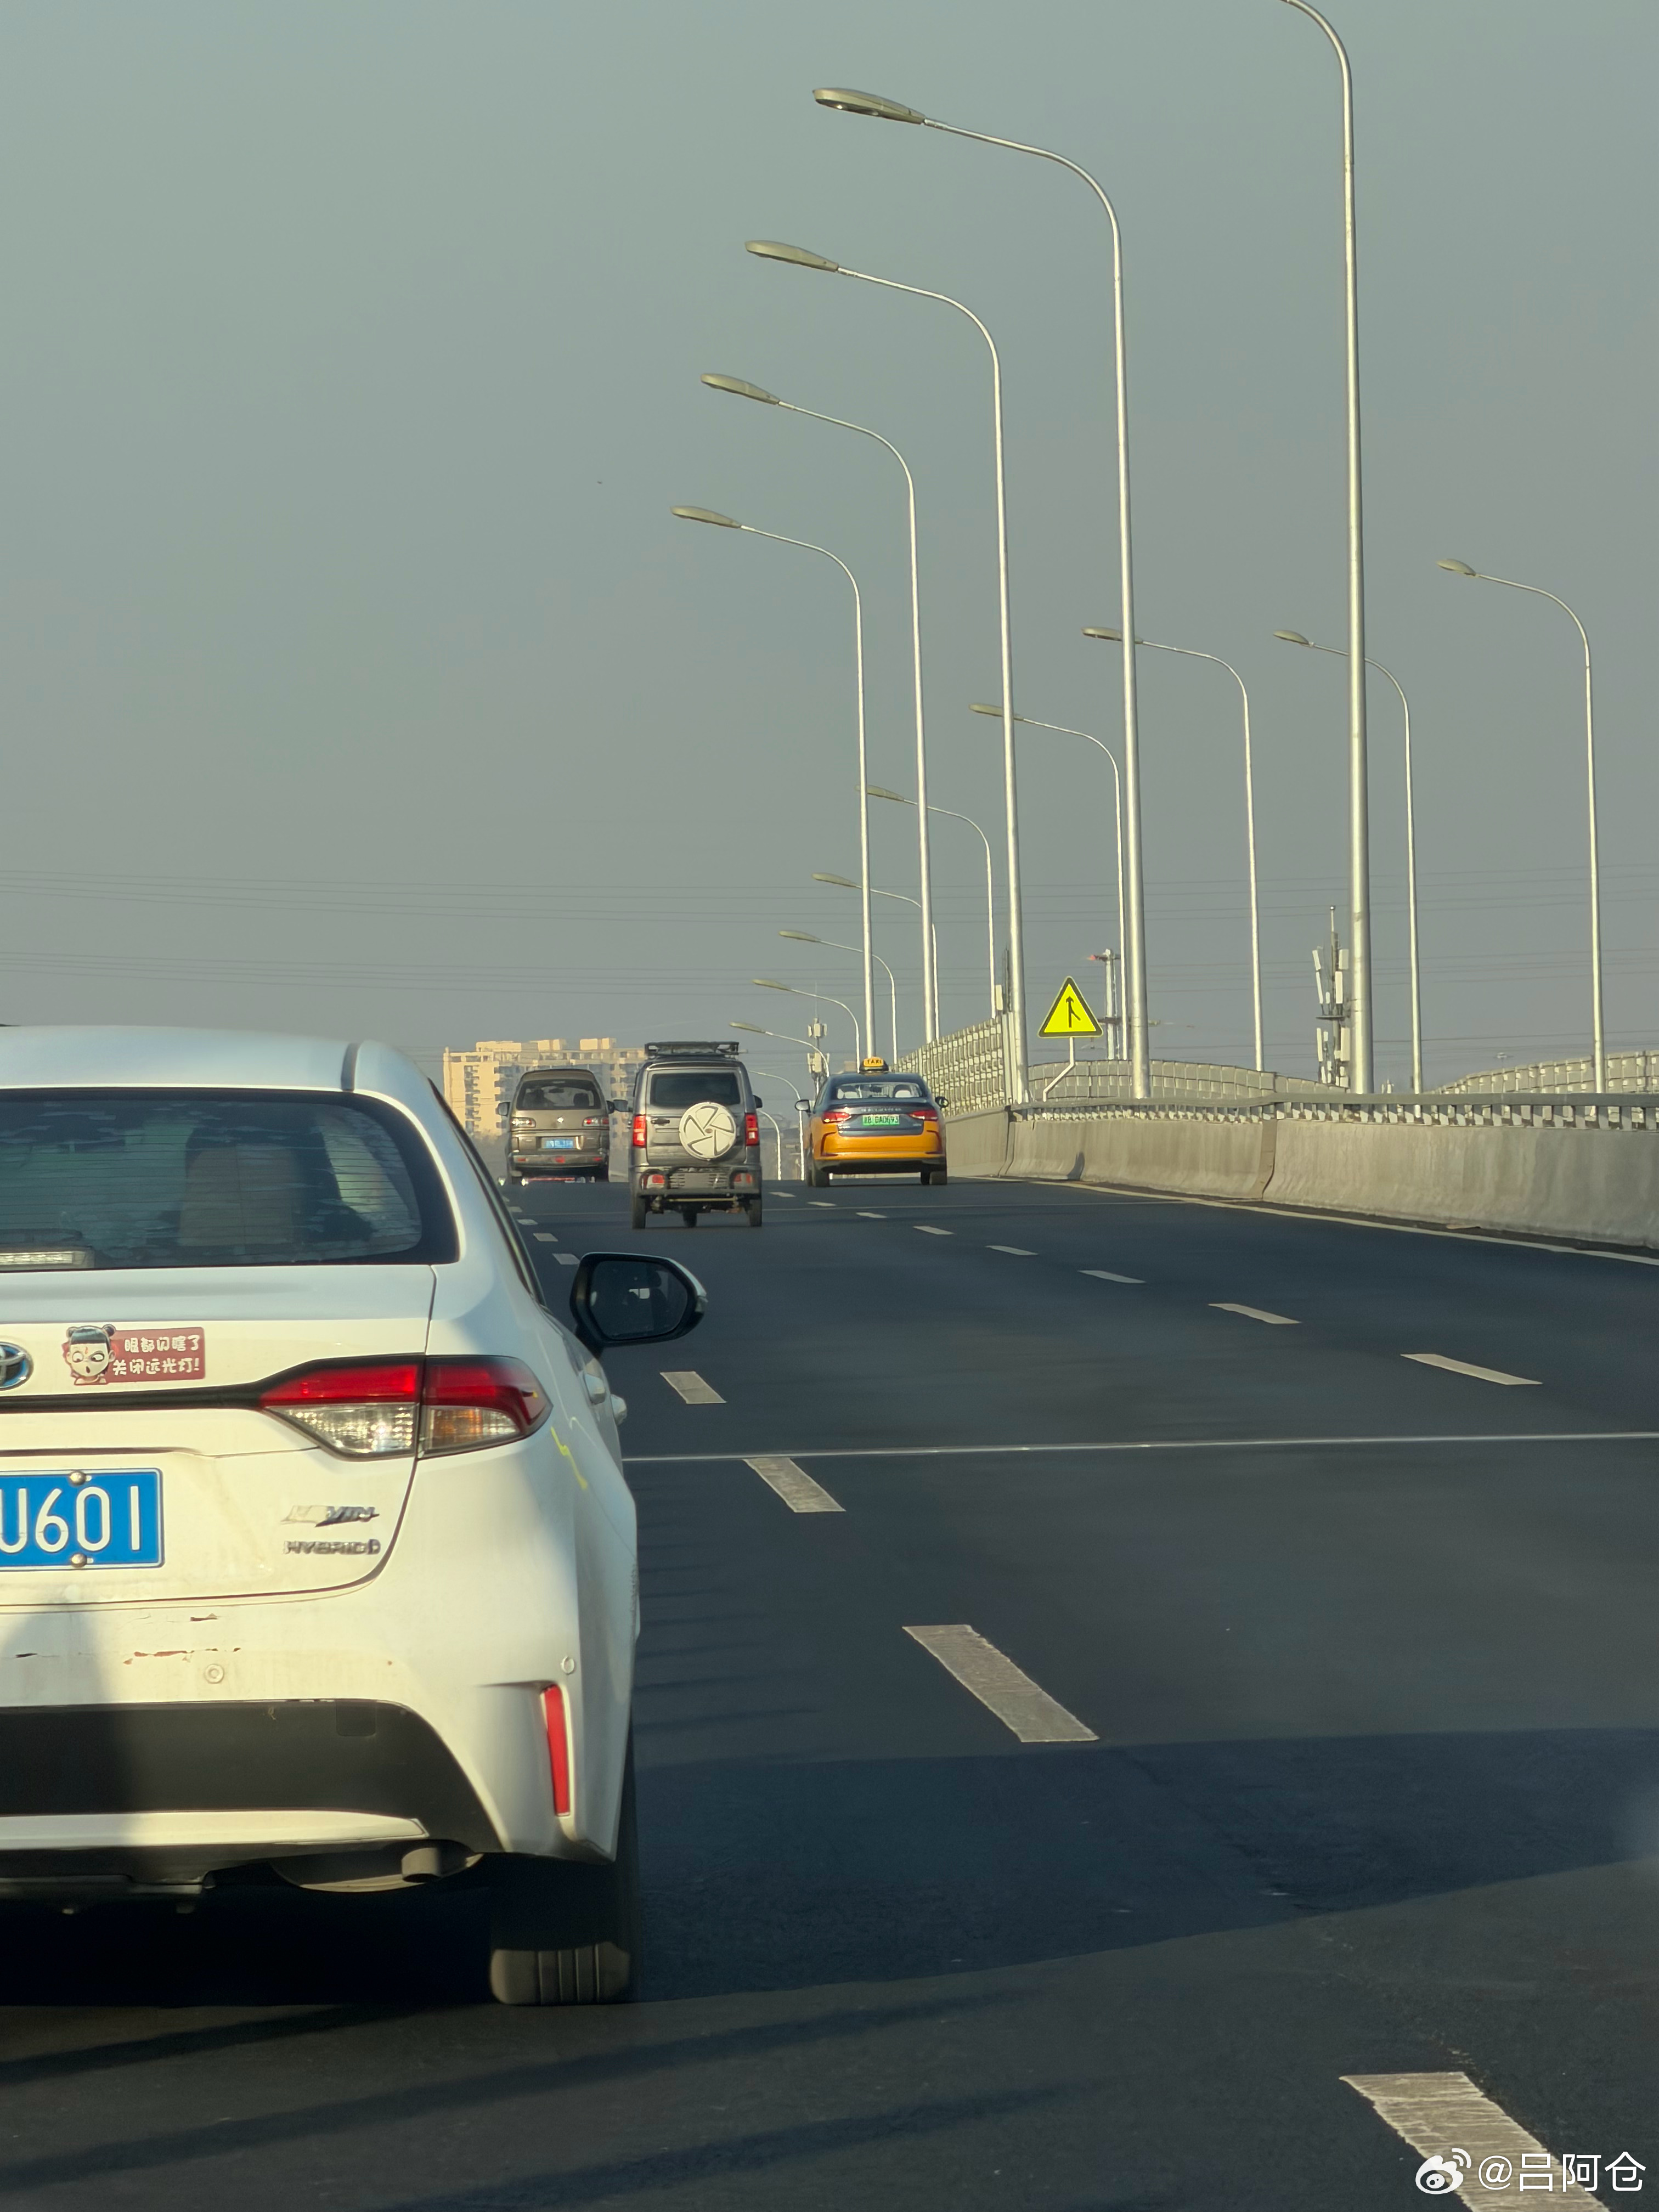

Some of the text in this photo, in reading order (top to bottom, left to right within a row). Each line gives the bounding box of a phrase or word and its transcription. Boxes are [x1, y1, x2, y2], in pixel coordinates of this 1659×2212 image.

[125, 1335, 200, 1353] 眼都闪瞎了
